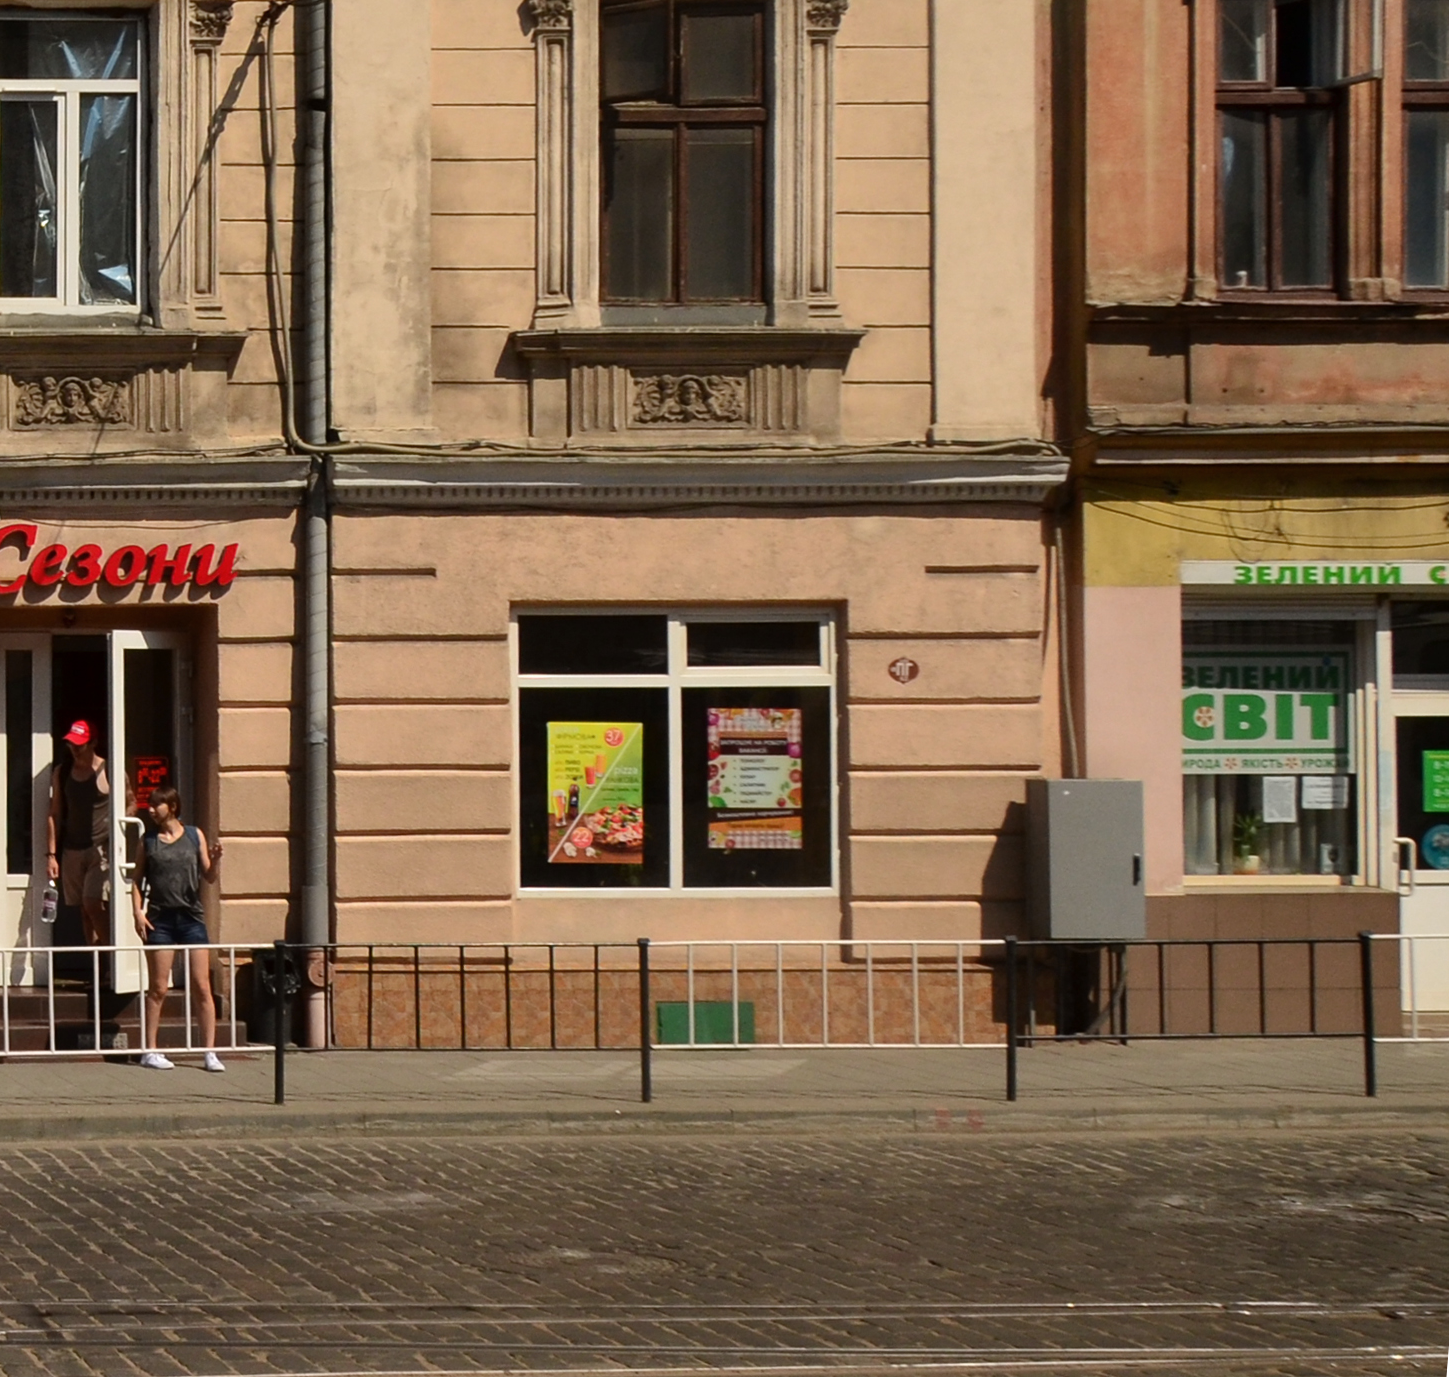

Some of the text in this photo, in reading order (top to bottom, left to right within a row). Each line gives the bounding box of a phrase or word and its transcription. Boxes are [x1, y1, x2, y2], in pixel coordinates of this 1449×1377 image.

[1234, 563, 1401, 584] ЗЕЛЕНИЙ
[1182, 693, 1339, 741] СВІТ
[606, 731, 621, 742] 37
[1241, 758, 1283, 769] ЯКІСТЬ
[573, 833, 589, 842] 22
